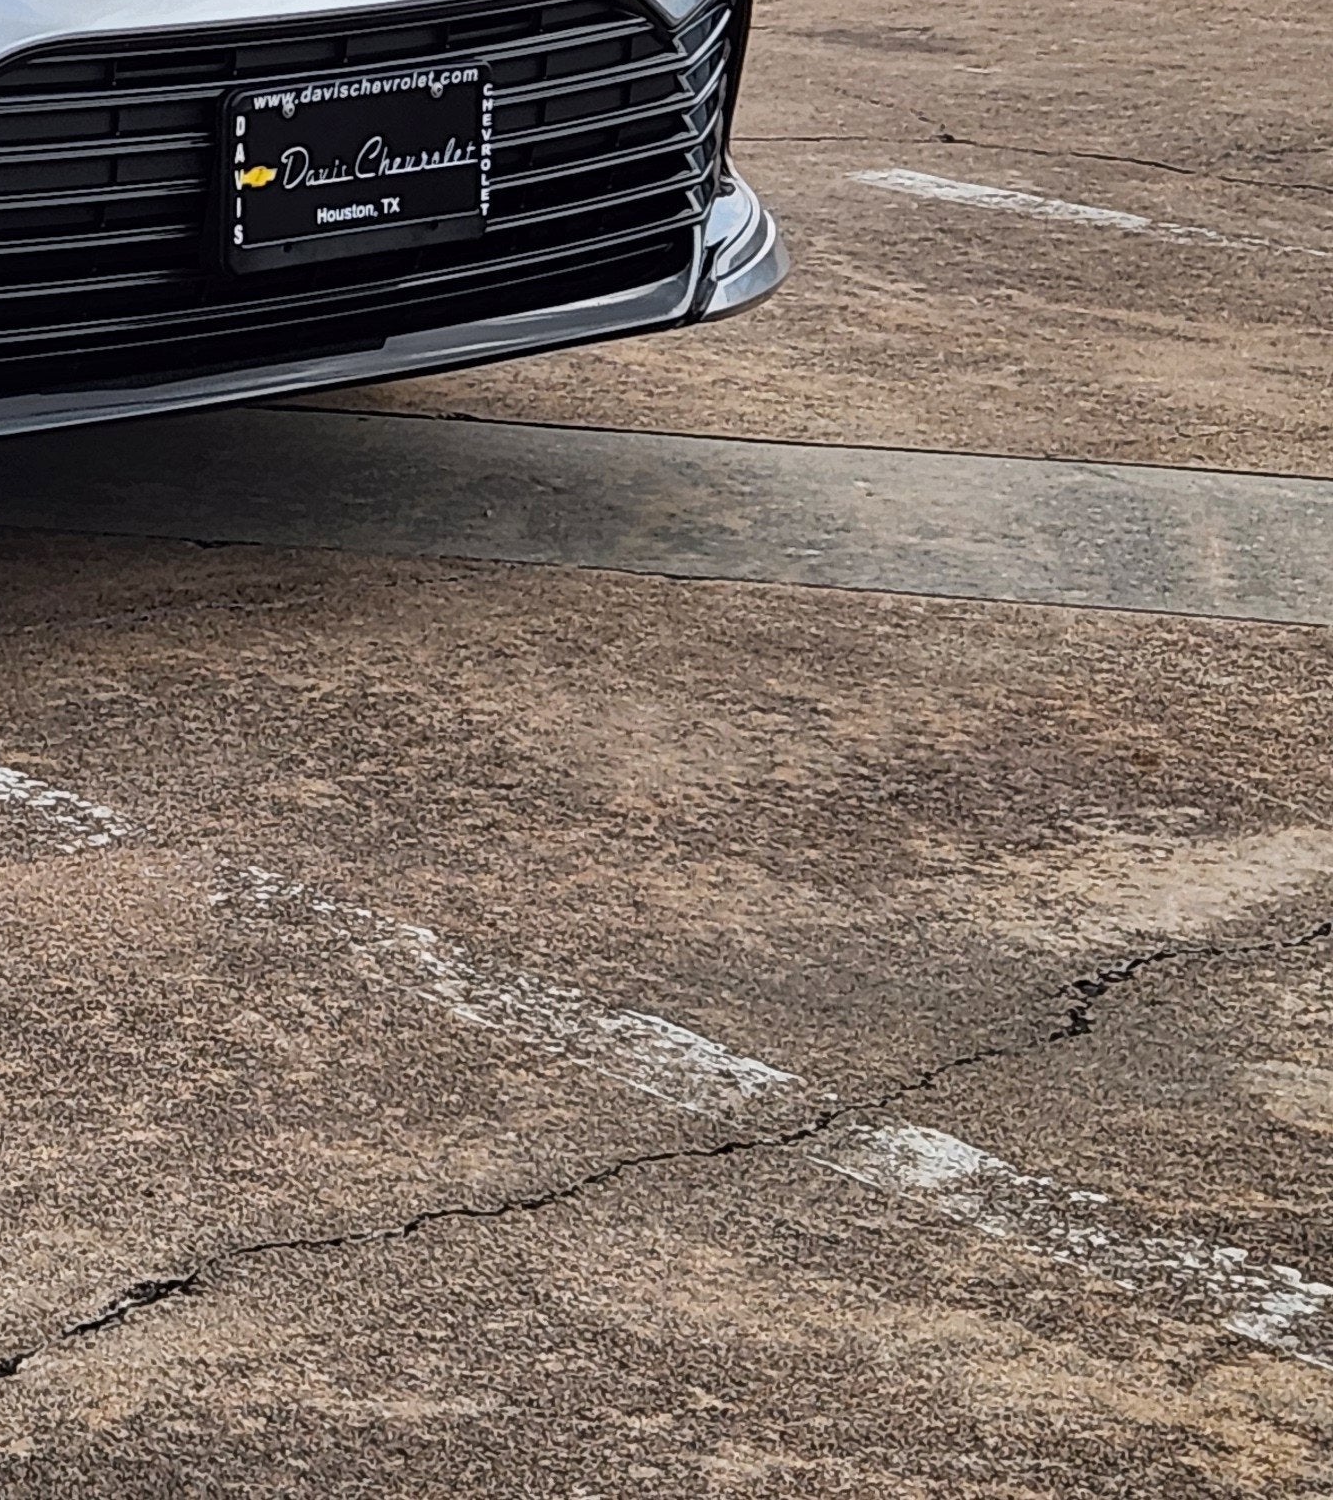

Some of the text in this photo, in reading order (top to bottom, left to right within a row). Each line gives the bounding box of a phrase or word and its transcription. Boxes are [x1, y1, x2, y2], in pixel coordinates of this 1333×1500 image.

[254, 67, 479, 110] www.davischevrolet.com
[233, 115, 245, 245] DAVIS
[481, 83, 494, 217] CHEVROLET
[316, 197, 401, 224] Houston, TX
